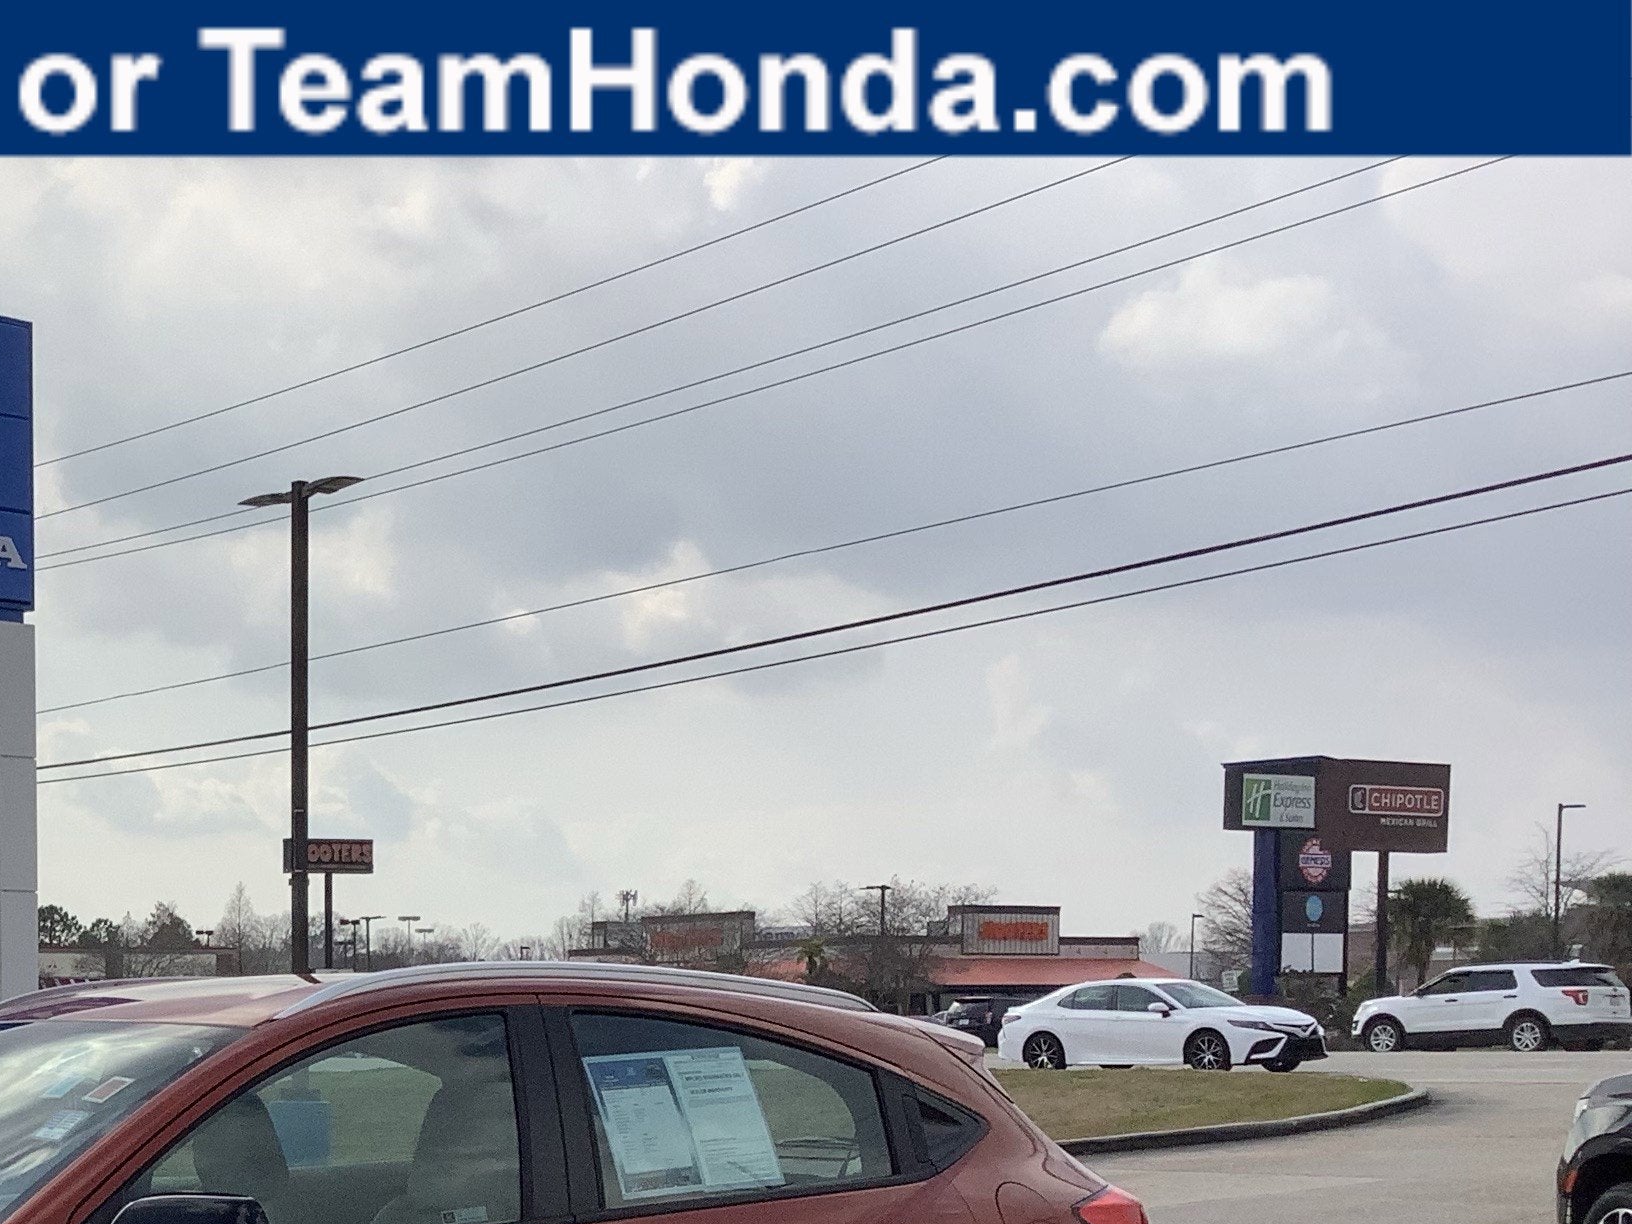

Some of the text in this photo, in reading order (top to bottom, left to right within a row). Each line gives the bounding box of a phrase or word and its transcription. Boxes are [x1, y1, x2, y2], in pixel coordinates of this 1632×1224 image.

[1273, 792, 1312, 811] Express
[1370, 792, 1439, 809] CHIPOTLE
[1380, 817, 1415, 827] MEXICAN
[307, 842, 372, 864] OOTERS
